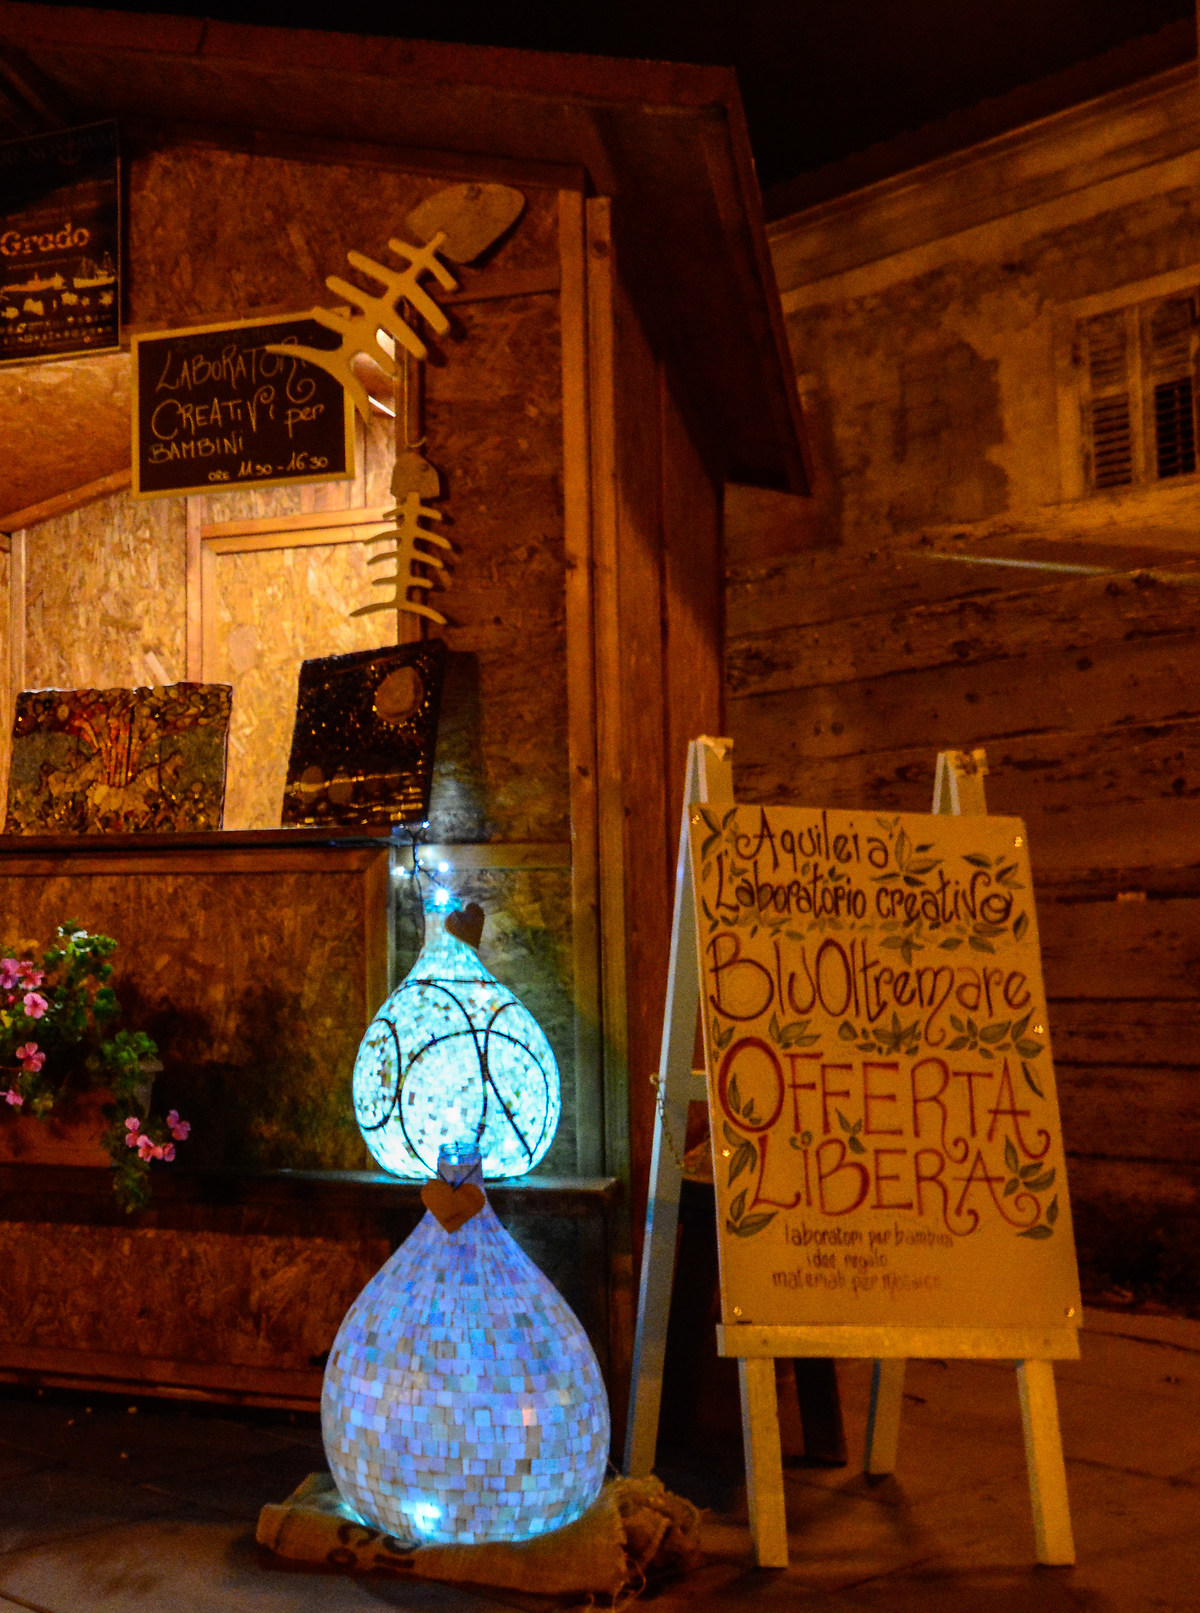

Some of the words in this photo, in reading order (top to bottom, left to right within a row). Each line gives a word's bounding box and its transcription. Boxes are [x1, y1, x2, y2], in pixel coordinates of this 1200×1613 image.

[0, 221, 91, 256] Grado
[283, 403, 325, 439] per
[735, 805, 889, 873] Aquileia
[715, 853, 867, 920] Laboratorio
[875, 868, 1013, 924] creativo
[718, 1036, 1051, 1164] OFFERTA
